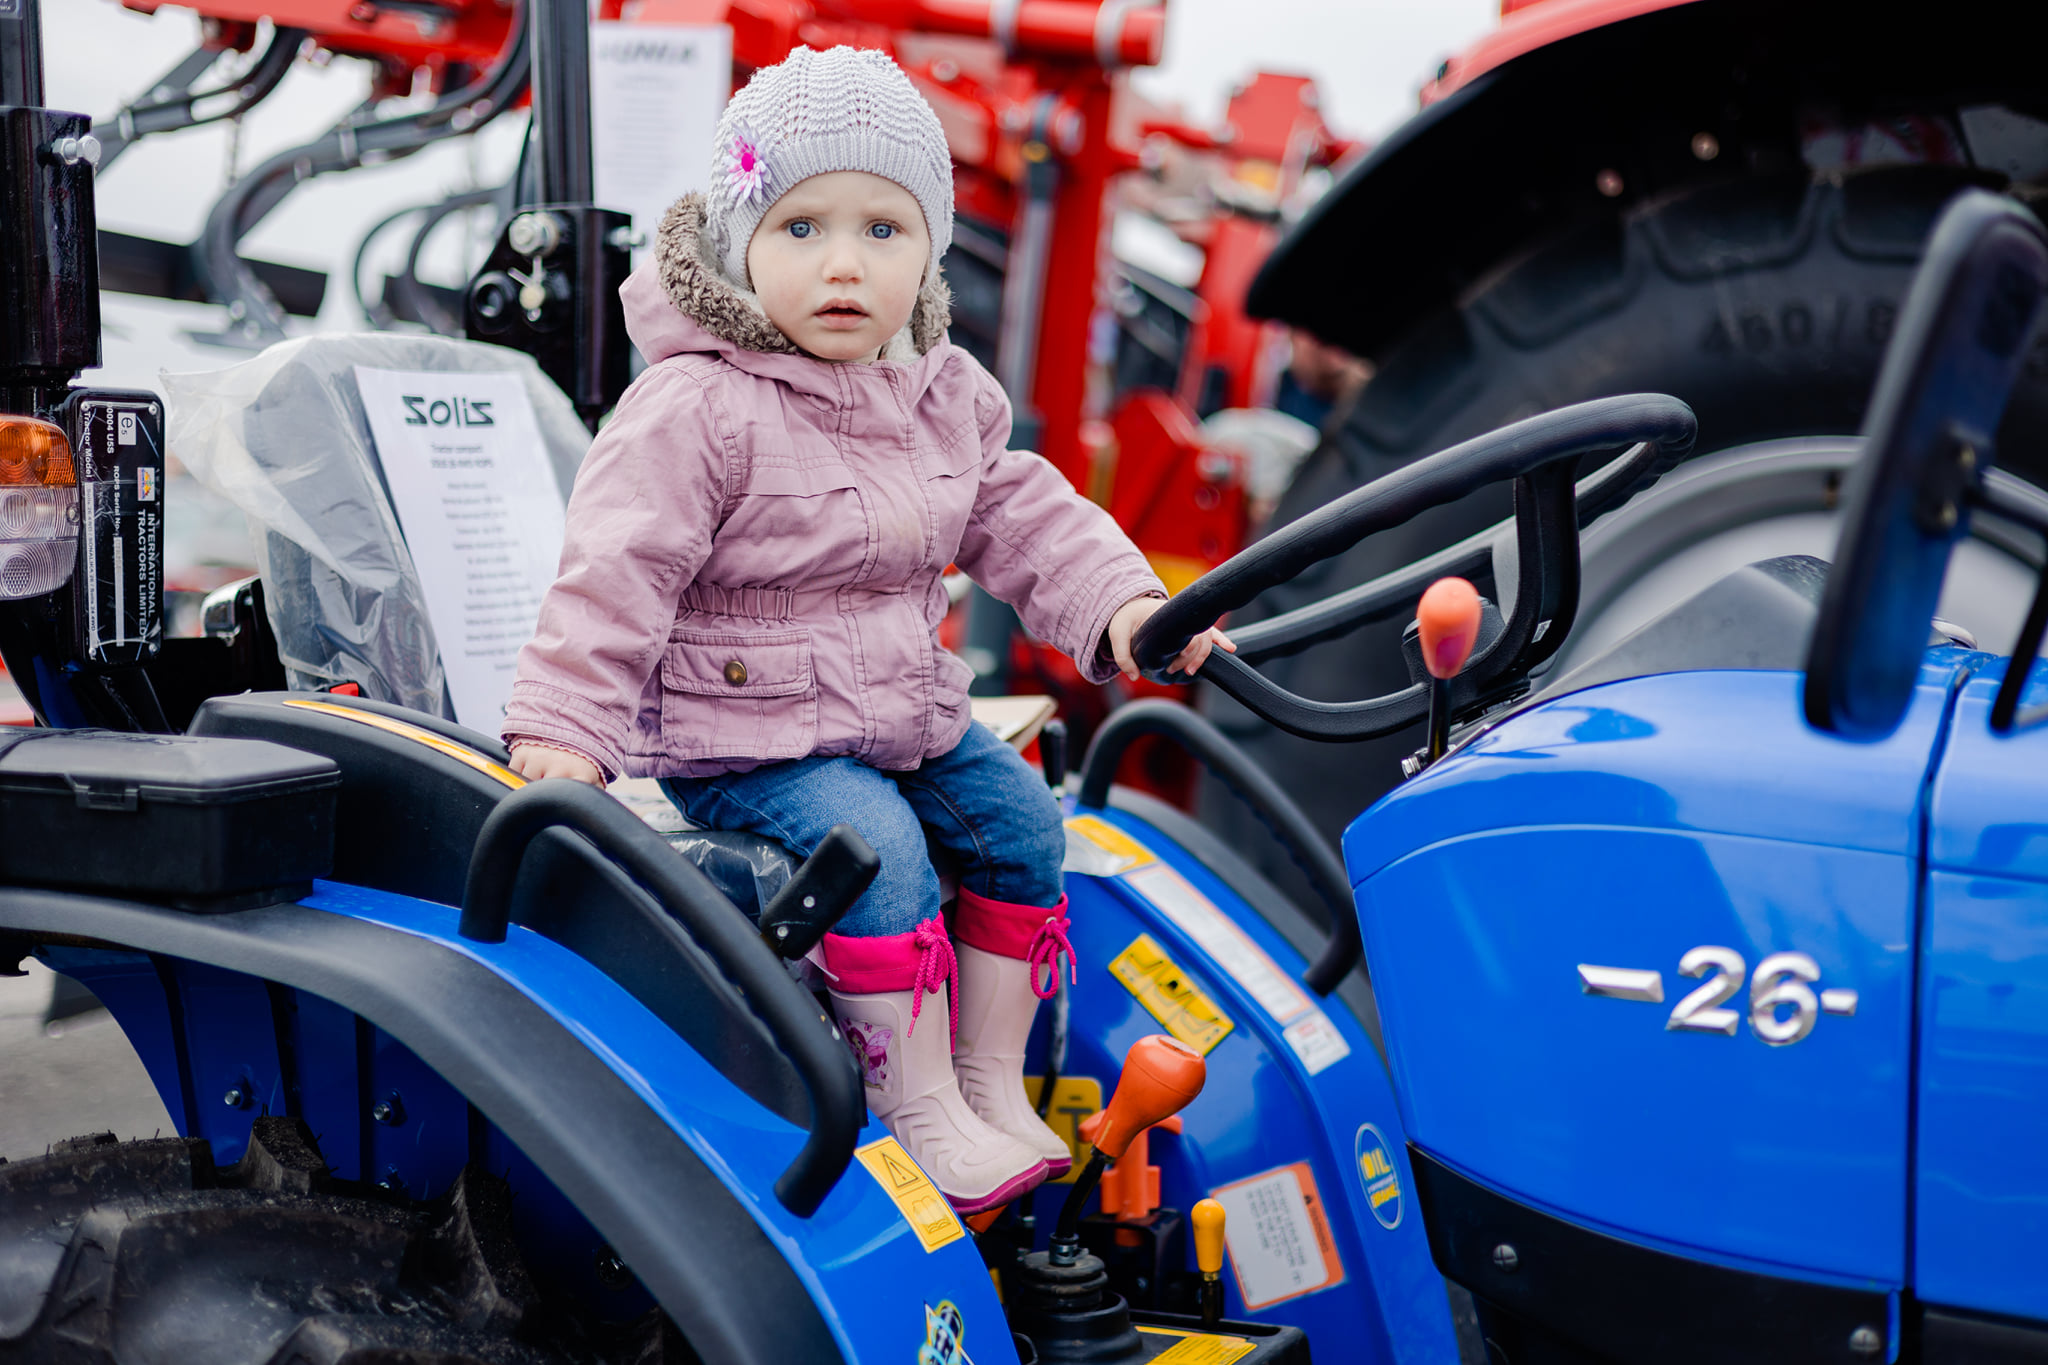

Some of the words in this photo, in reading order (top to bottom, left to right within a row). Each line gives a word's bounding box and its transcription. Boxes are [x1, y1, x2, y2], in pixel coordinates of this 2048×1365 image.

[84, 411, 92, 446] Tractor
[85, 447, 93, 478] Model
[113, 492, 121, 516] Serial
[138, 508, 147, 582] TRACTORS
[147, 513, 157, 618] INTERNATIONAL
[138, 584, 147, 637] LIMITED
